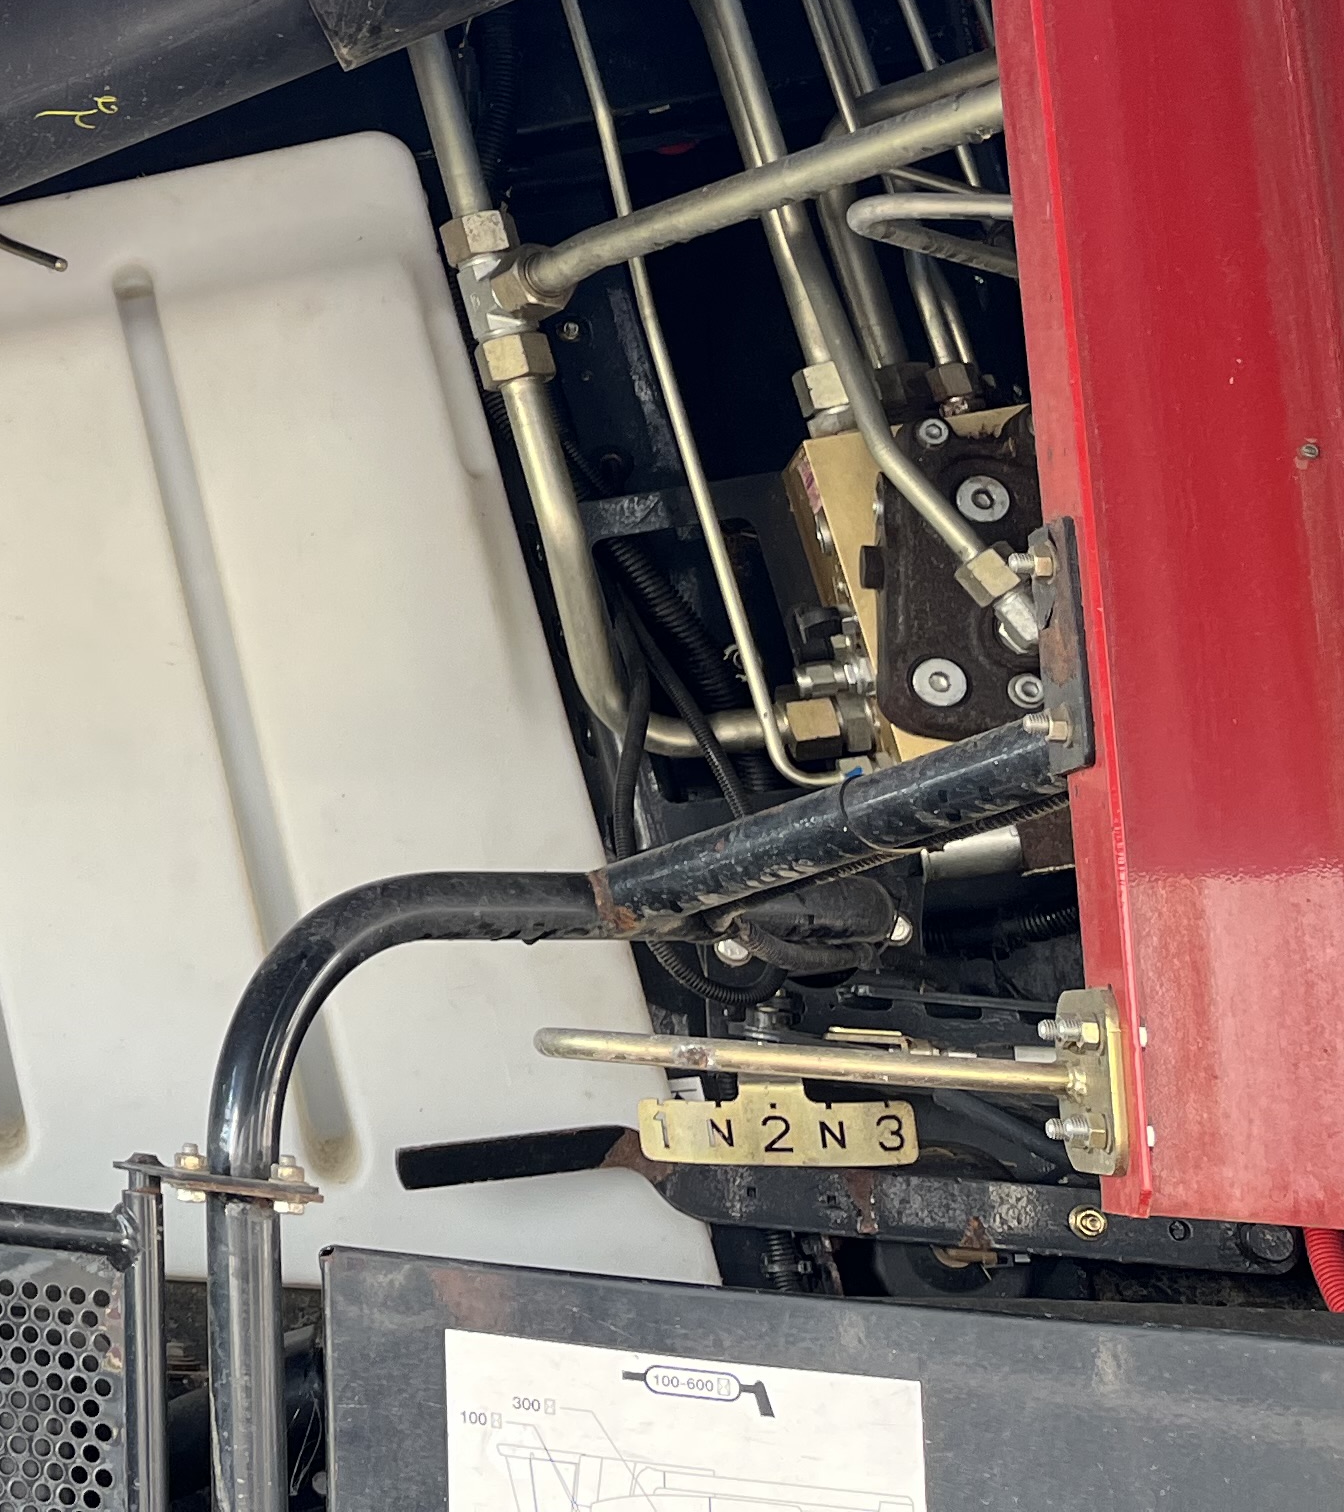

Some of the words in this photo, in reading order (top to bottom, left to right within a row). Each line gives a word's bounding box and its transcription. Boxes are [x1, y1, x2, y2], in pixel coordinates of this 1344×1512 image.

[653, 1111, 670, 1149] 1
[707, 1118, 735, 1148] N
[761, 1115, 795, 1154] 2
[818, 1120, 848, 1150] N
[875, 1114, 907, 1152] 3
[652, 1373, 714, 1392] 100-600
[512, 1395, 541, 1412] 300
[460, 1411, 487, 1427] 100
